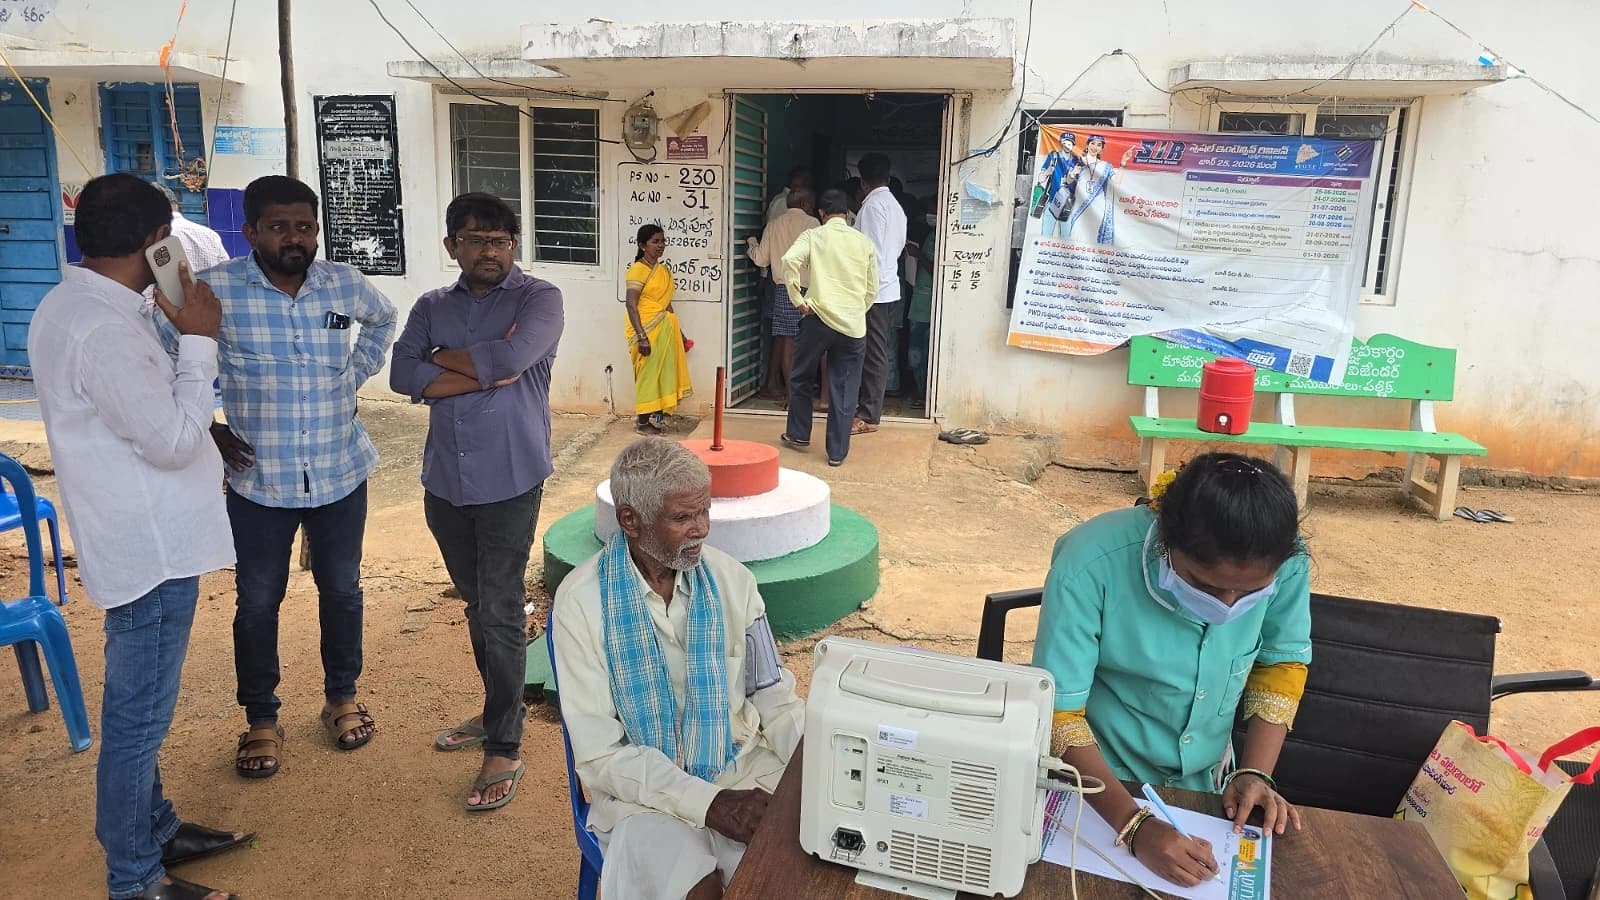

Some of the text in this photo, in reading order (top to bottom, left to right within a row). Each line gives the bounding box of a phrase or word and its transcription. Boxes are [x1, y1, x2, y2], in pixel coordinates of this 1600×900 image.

[630, 171, 642, 182] PS
[679, 168, 716, 186] 230
[631, 191, 645, 202] AC
[683, 190, 709, 209] 31
[1247, 352, 1276, 366] 1950
